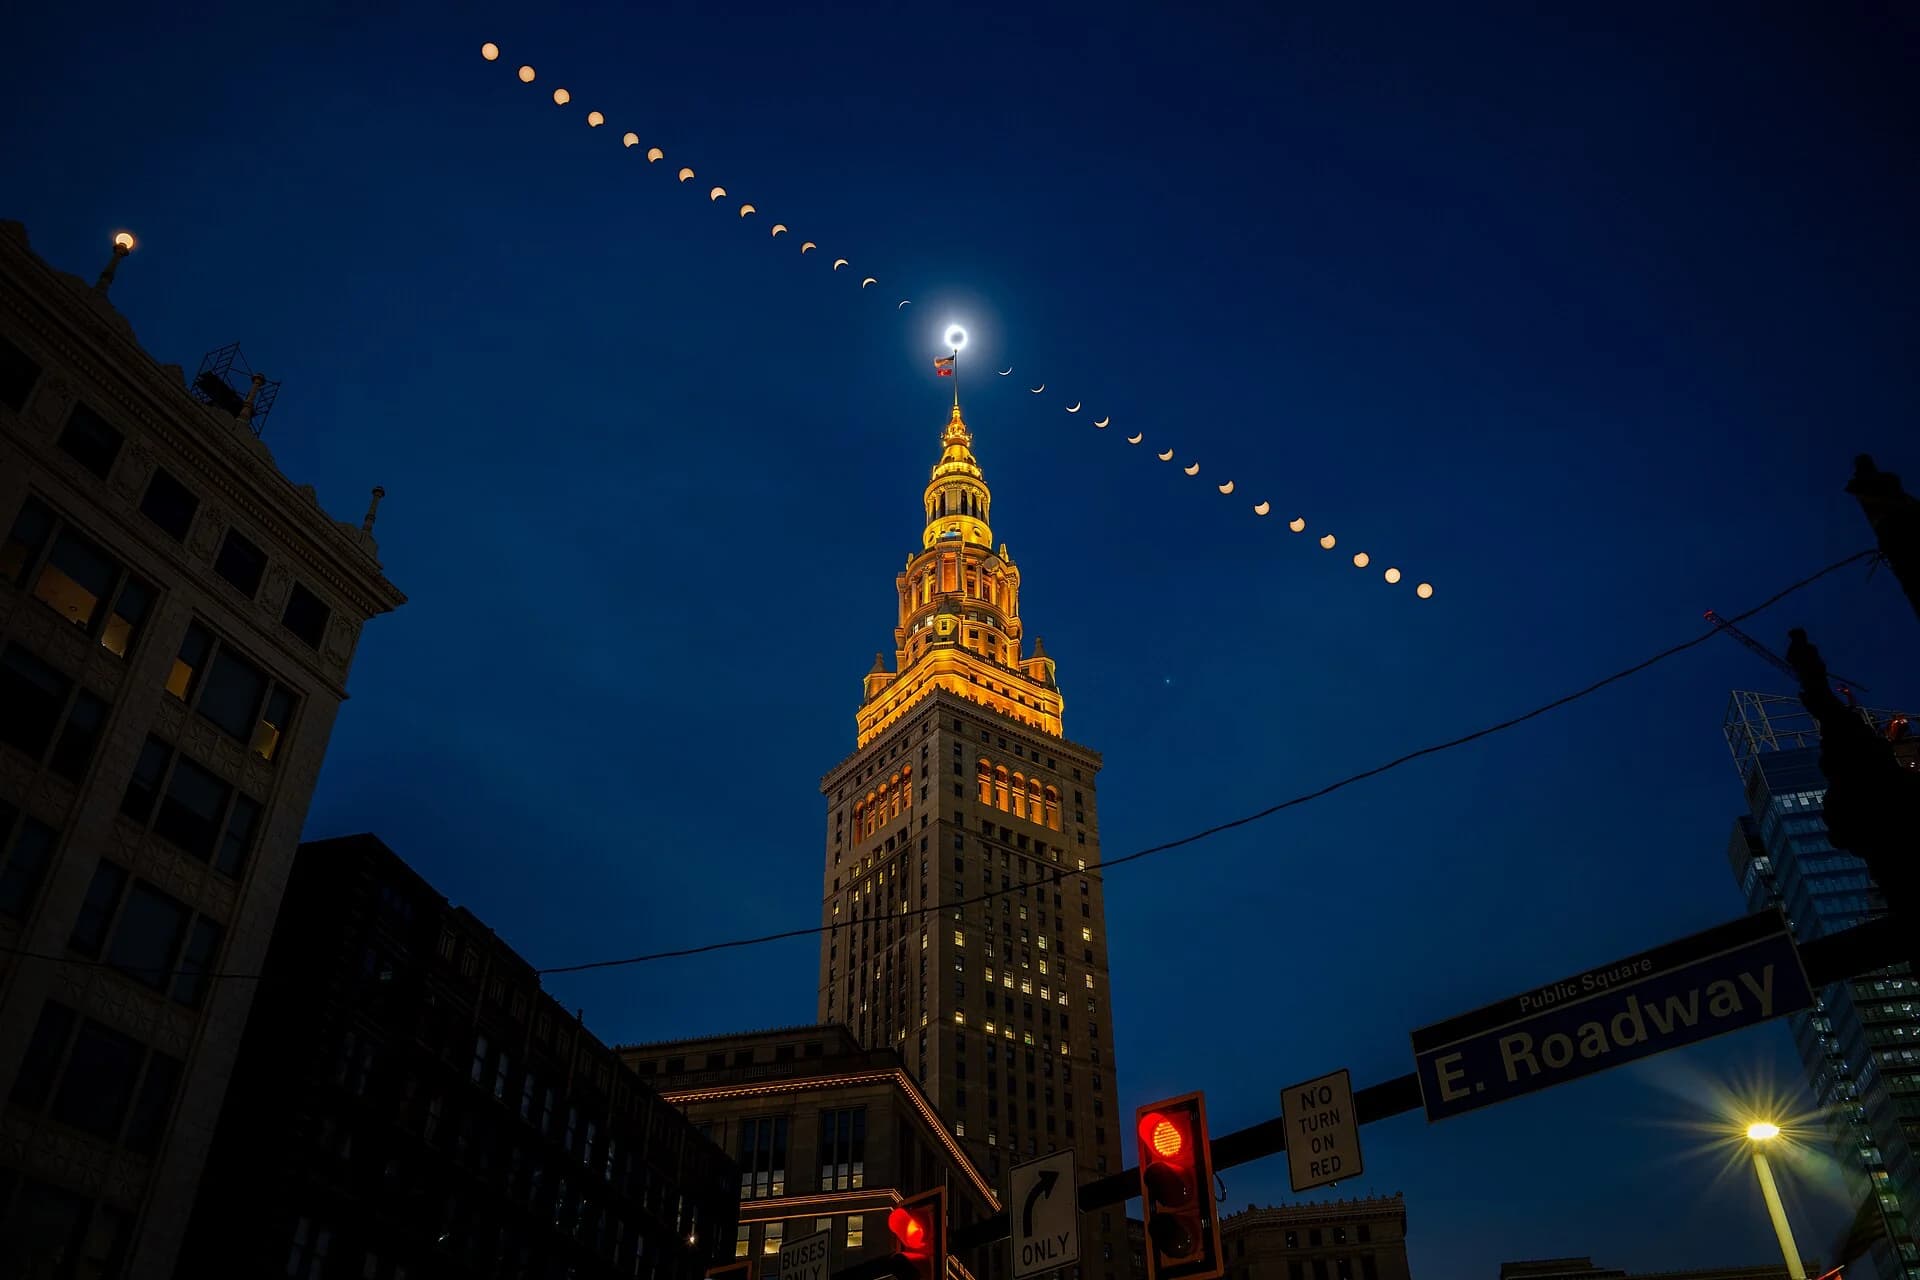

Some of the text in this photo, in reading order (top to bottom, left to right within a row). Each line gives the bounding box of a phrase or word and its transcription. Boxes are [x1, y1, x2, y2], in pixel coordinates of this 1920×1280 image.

[1519, 957, 1654, 1013] Public Square
[1434, 963, 1775, 1102] E. Roadway
[1301, 1086, 1332, 1110] NO
[1299, 1109, 1341, 1134] TURN
[1311, 1134, 1335, 1153] ON
[1310, 1155, 1342, 1178] RED
[783, 1240, 825, 1270] BUSES
[1022, 1231, 1070, 1267] ONLY
